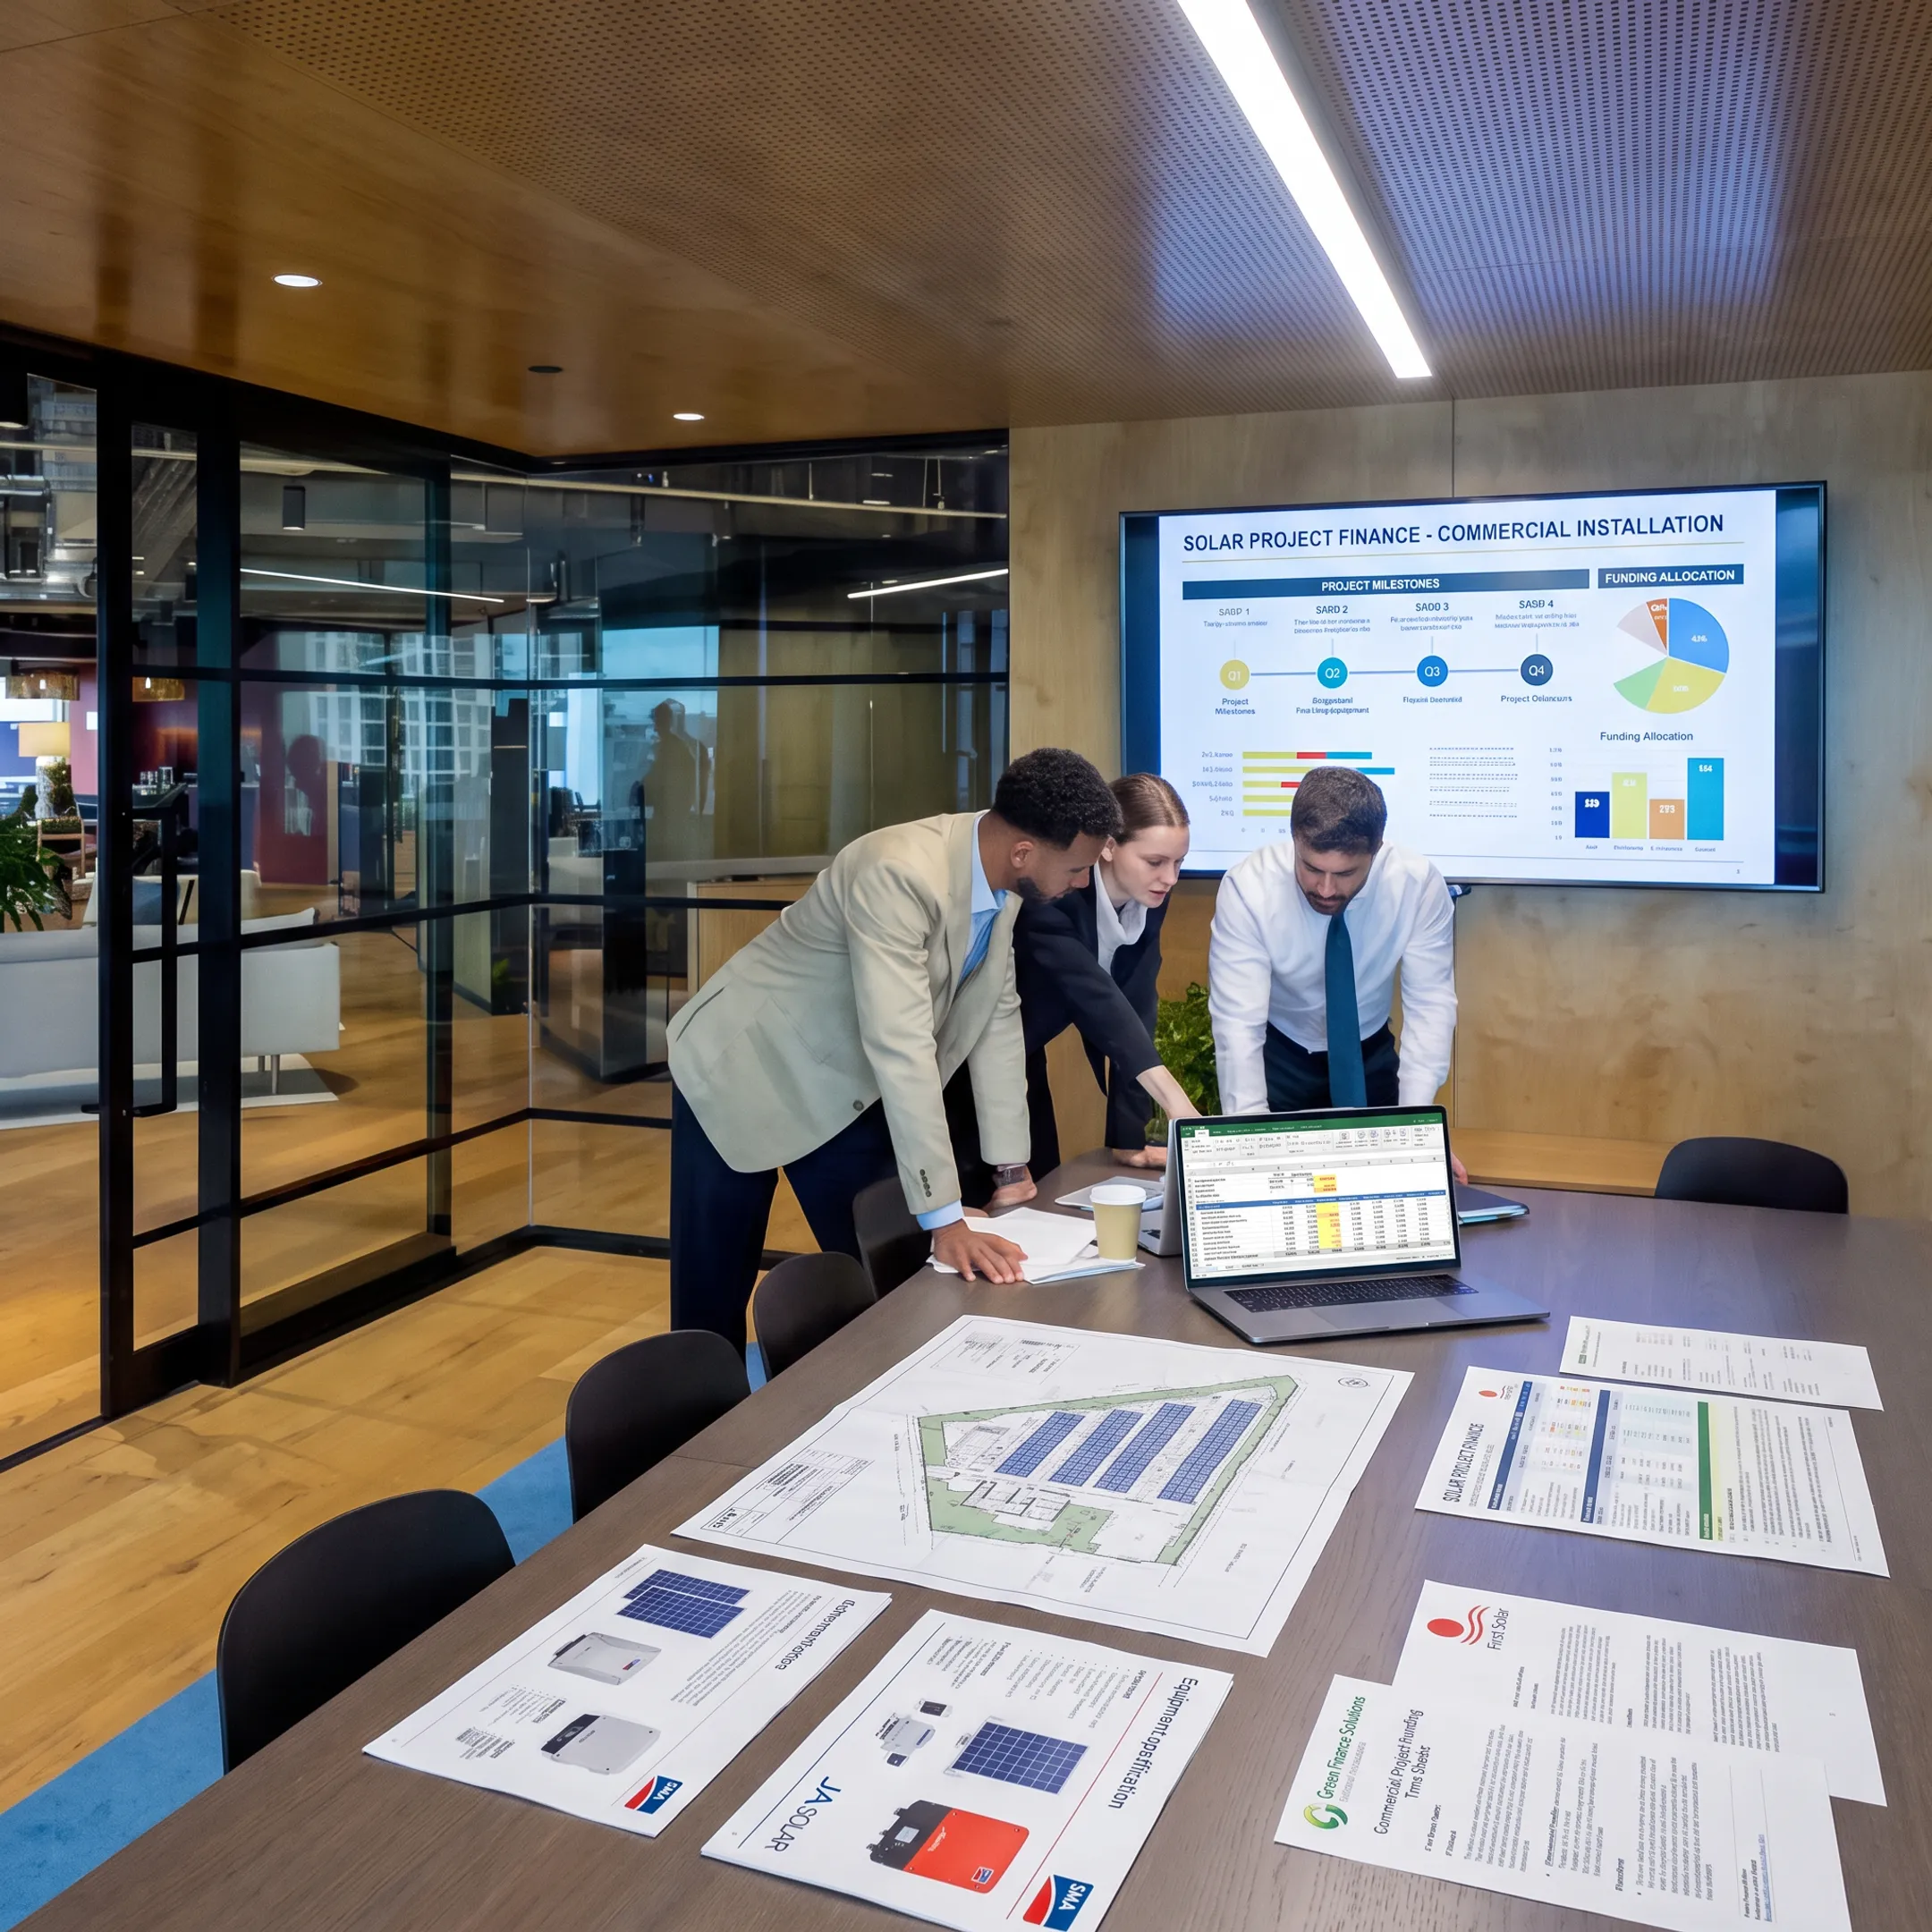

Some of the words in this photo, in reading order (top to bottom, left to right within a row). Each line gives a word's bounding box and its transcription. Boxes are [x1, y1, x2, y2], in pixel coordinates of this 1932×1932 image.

[1183, 533, 1244, 551] SOLAR
[1250, 530, 1333, 549] PROJECT
[1339, 527, 1420, 546] FINANCE
[1437, 521, 1572, 542] COMMERCIAL
[1577, 514, 1724, 537] INSTALLATION
[1605, 572, 1657, 584] FUNDING
[1658, 570, 1735, 582] ALLOCATION
[1321, 580, 1370, 591] PROJECT
[1372, 579, 1440, 590] MILESTONES
[1342, 606, 1349, 614] 2
[1443, 602, 1449, 611] 3
[1547, 600, 1554, 608] 4
[1228, 671, 1241, 682] Q1
[1325, 668, 1340, 679] Q2
[1424, 666, 1441, 677] Q3
[1529, 665, 1545, 676] Q4
[1222, 699, 1249, 707] Project
[1500, 695, 1530, 703] Project
[1599, 732, 1640, 743] Funding
[1643, 731, 1693, 741] Allocation
[1491, 1608, 1510, 1631] Solar
[1487, 1631, 1504, 1650] First
[803, 1776, 842, 1804] JA
[1317, 1769, 1341, 1800] Green
[652, 1781, 679, 1801] SMA
[764, 1805, 818, 1852] SOLAR
[1058, 1883, 1087, 1911] SMA
